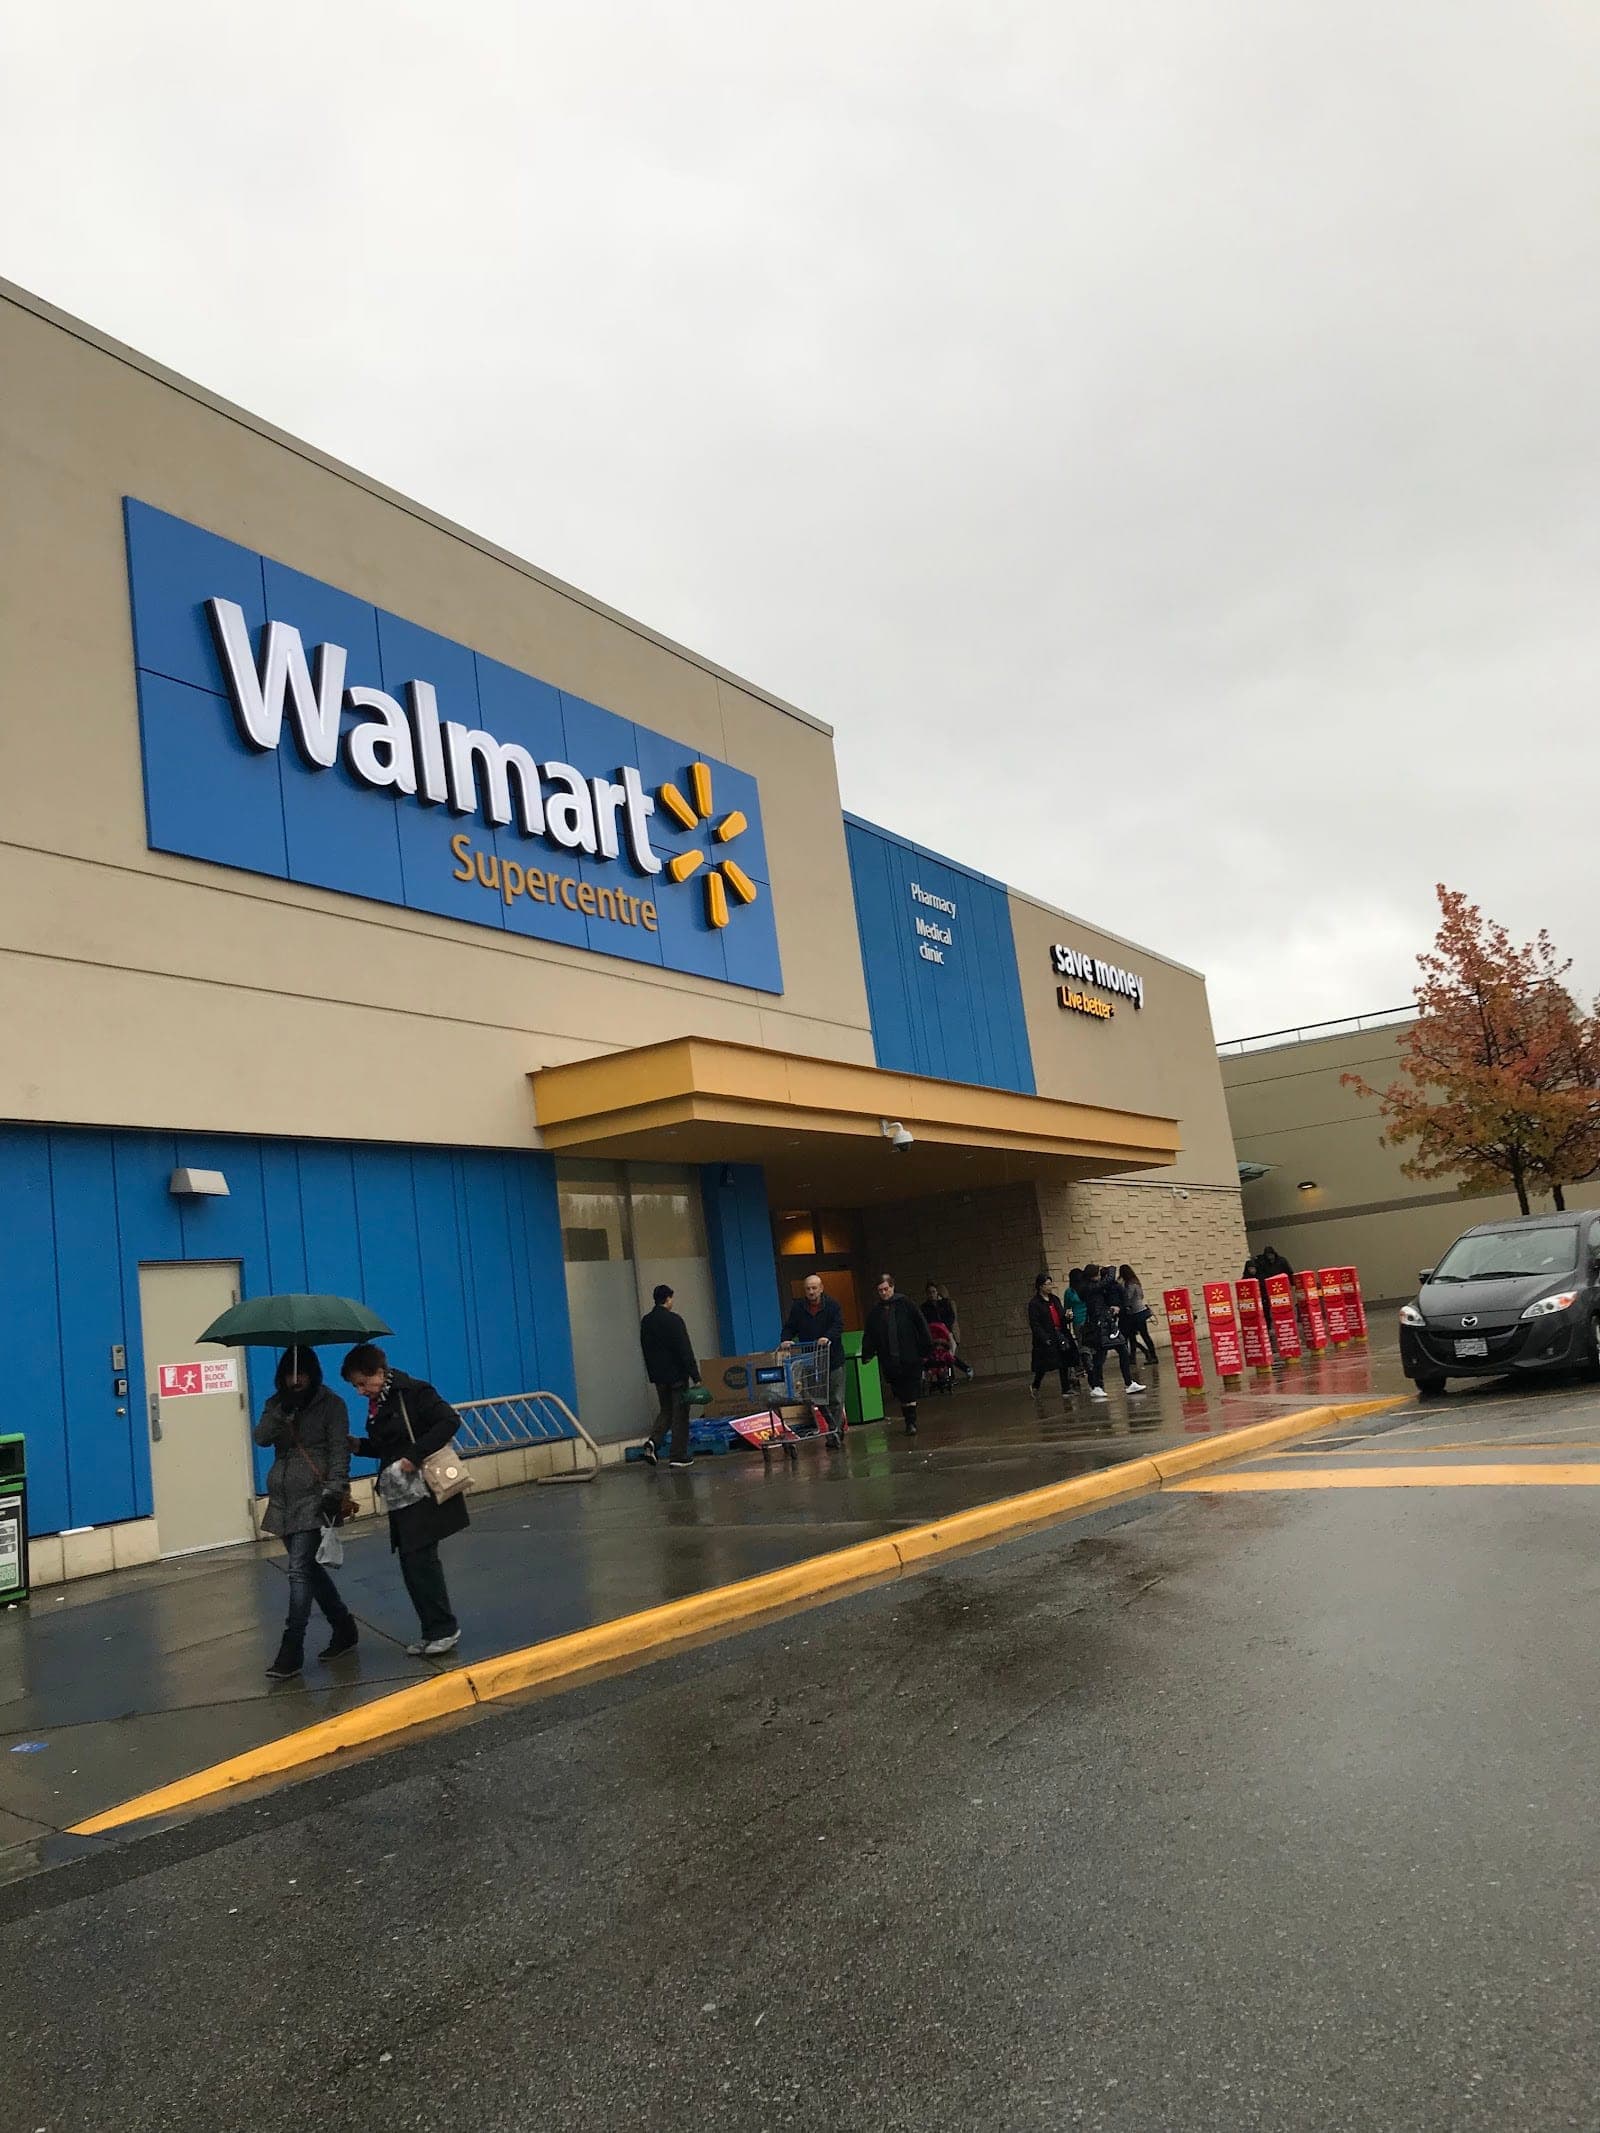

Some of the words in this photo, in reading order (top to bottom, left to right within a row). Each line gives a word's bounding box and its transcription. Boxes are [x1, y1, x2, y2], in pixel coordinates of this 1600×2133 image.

[208, 597, 662, 874] Walmart
[452, 834, 658, 931] Supercentre
[911, 882, 956, 919] Pharmacy
[915, 917, 952, 945] Medical
[920, 941, 944, 965] clinic
[1055, 944, 1093, 982] save
[1094, 959, 1144, 1009] money
[1062, 985, 1082, 1010] Live
[1081, 992, 1111, 1018] better
[204, 1365, 214, 1373] DO
[214, 1363, 228, 1372] NOT
[204, 1373, 225, 1381] BLOCK
[219, 1380, 233, 1388] EXIT
